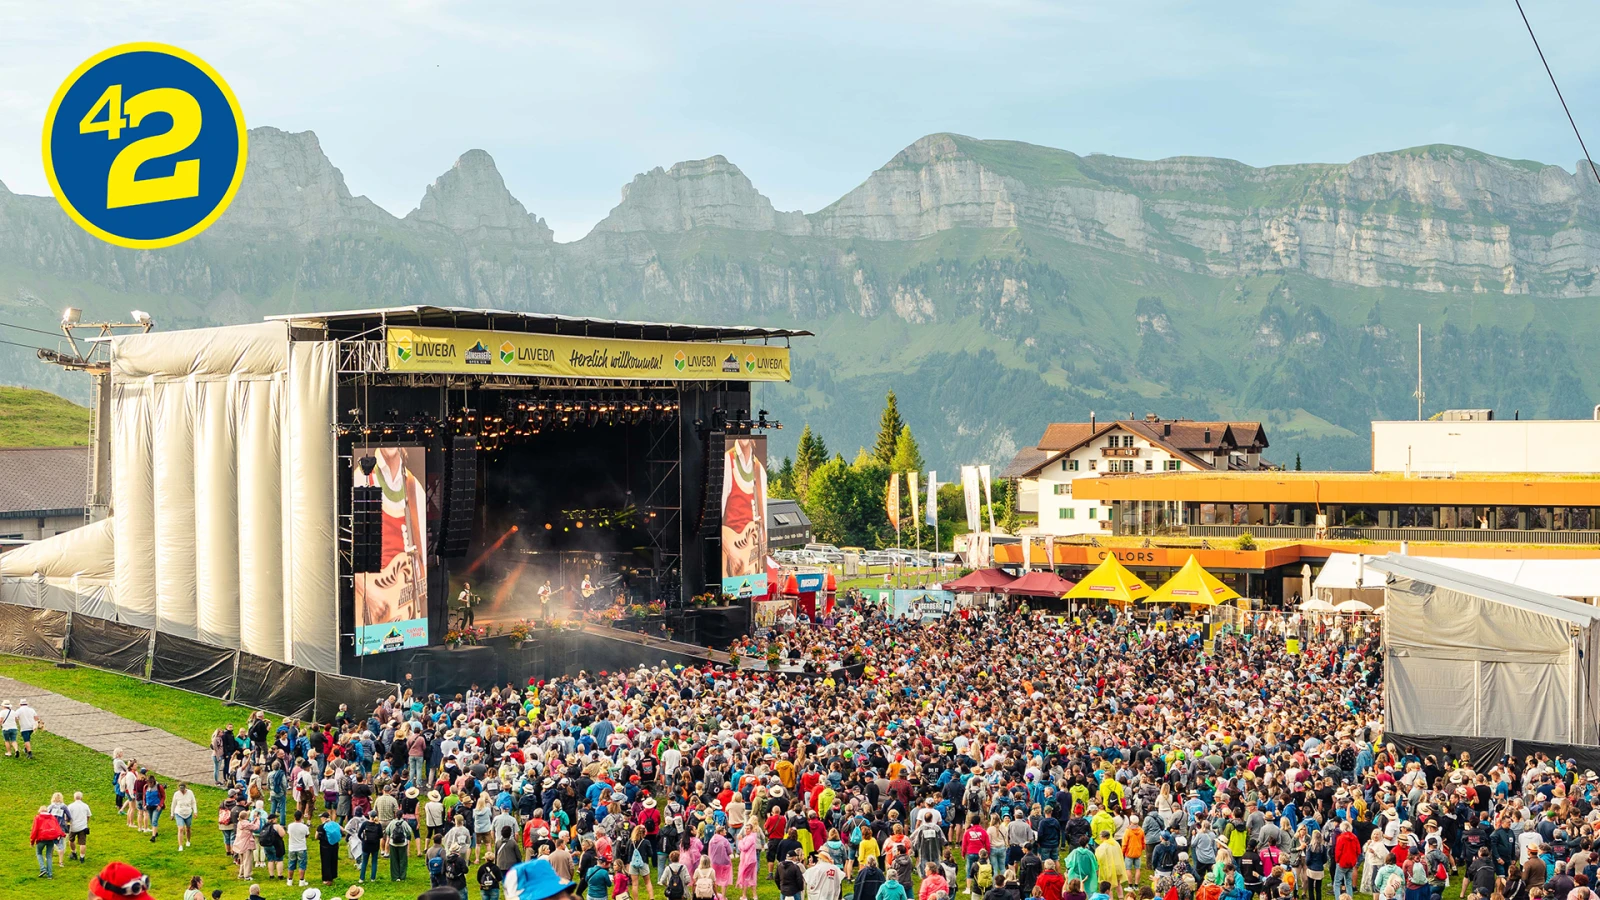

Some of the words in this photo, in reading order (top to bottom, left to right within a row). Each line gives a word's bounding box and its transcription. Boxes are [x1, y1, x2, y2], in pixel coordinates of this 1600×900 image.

[415, 343, 456, 357] LAVEBA
[518, 347, 555, 361] LAVEBA
[569, 348, 608, 368] Herzlich
[610, 351, 663, 370] willkommen!
[688, 356, 716, 367] LAVEBA
[757, 358, 783, 369] LAVEBA
[1098, 551, 1154, 562] CLORS
